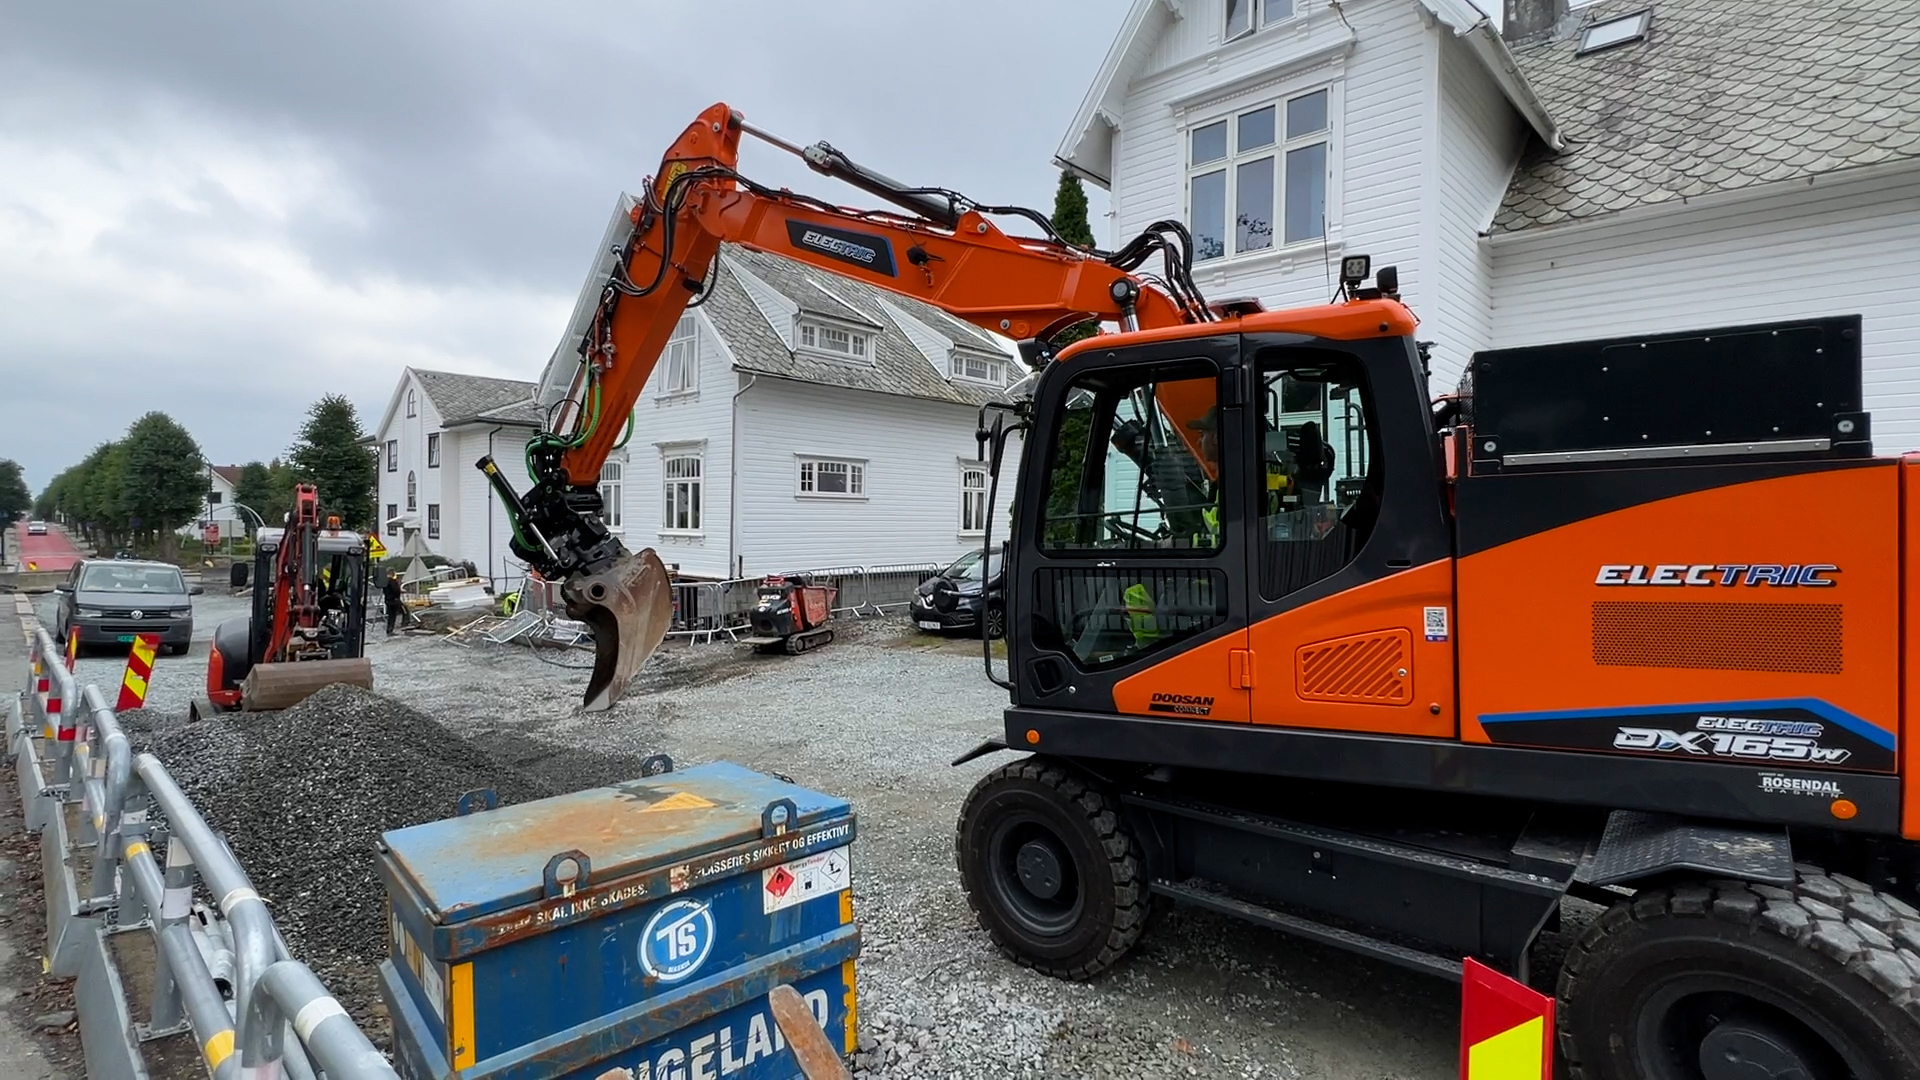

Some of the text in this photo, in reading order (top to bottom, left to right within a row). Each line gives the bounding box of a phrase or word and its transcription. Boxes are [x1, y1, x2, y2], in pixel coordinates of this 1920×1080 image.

[802, 230, 876, 263] ELECTRIC
[1595, 564, 1841, 588] ELECTRIC
[1151, 693, 1215, 706] DOOSAN
[1173, 705, 1210, 715] CONNECT
[1696, 716, 1824, 737] ELECTRIC
[1762, 776, 1841, 792] ROSENDAL
[1763, 788, 1840, 798] MASKIN
[571, 896, 598, 916] IKKE
[753, 840, 791, 861] SIKKERT
[792, 836, 806, 850] OG
[656, 903, 709, 960] TS
